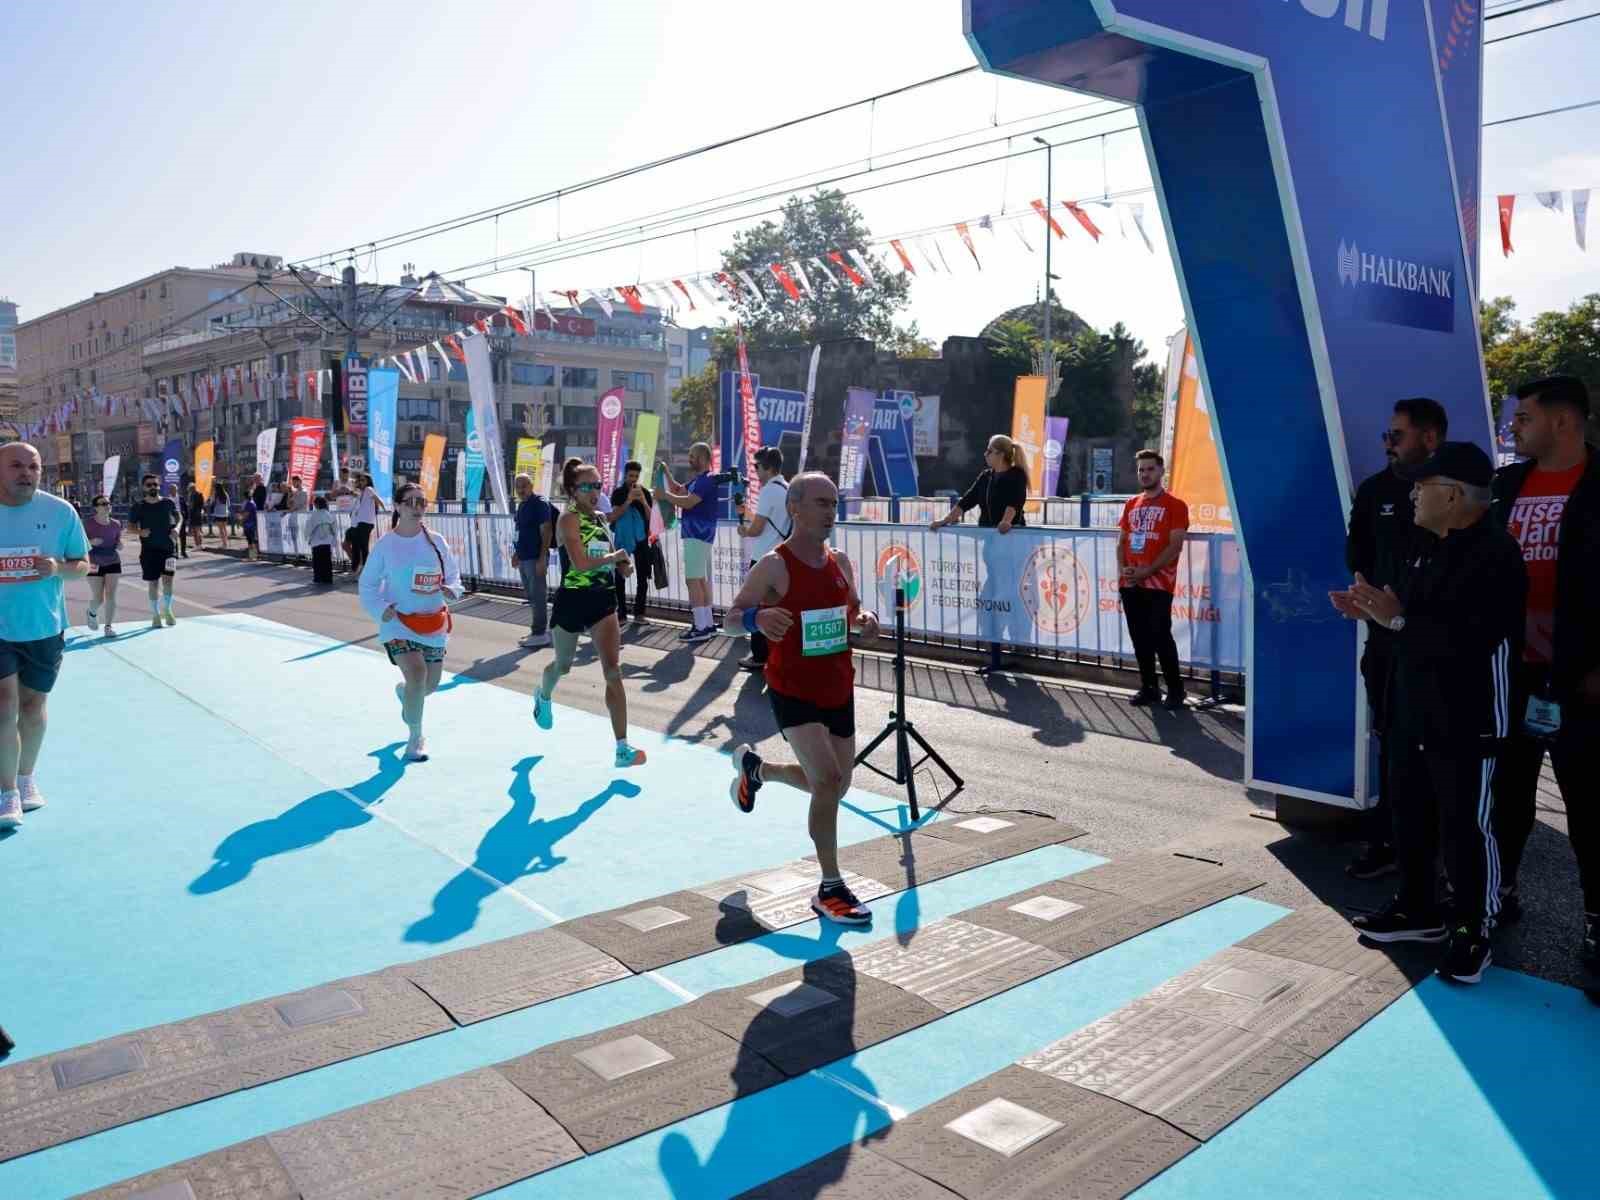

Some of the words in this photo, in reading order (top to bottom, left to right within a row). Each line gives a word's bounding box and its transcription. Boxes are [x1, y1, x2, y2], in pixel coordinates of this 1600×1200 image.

[1361, 252, 1451, 298] HALKBANK
[759, 397, 804, 423] START
[872, 408, 899, 430] TART
[351, 459, 363, 469] 30
[931, 594, 1011, 613] FEDERASYONU
